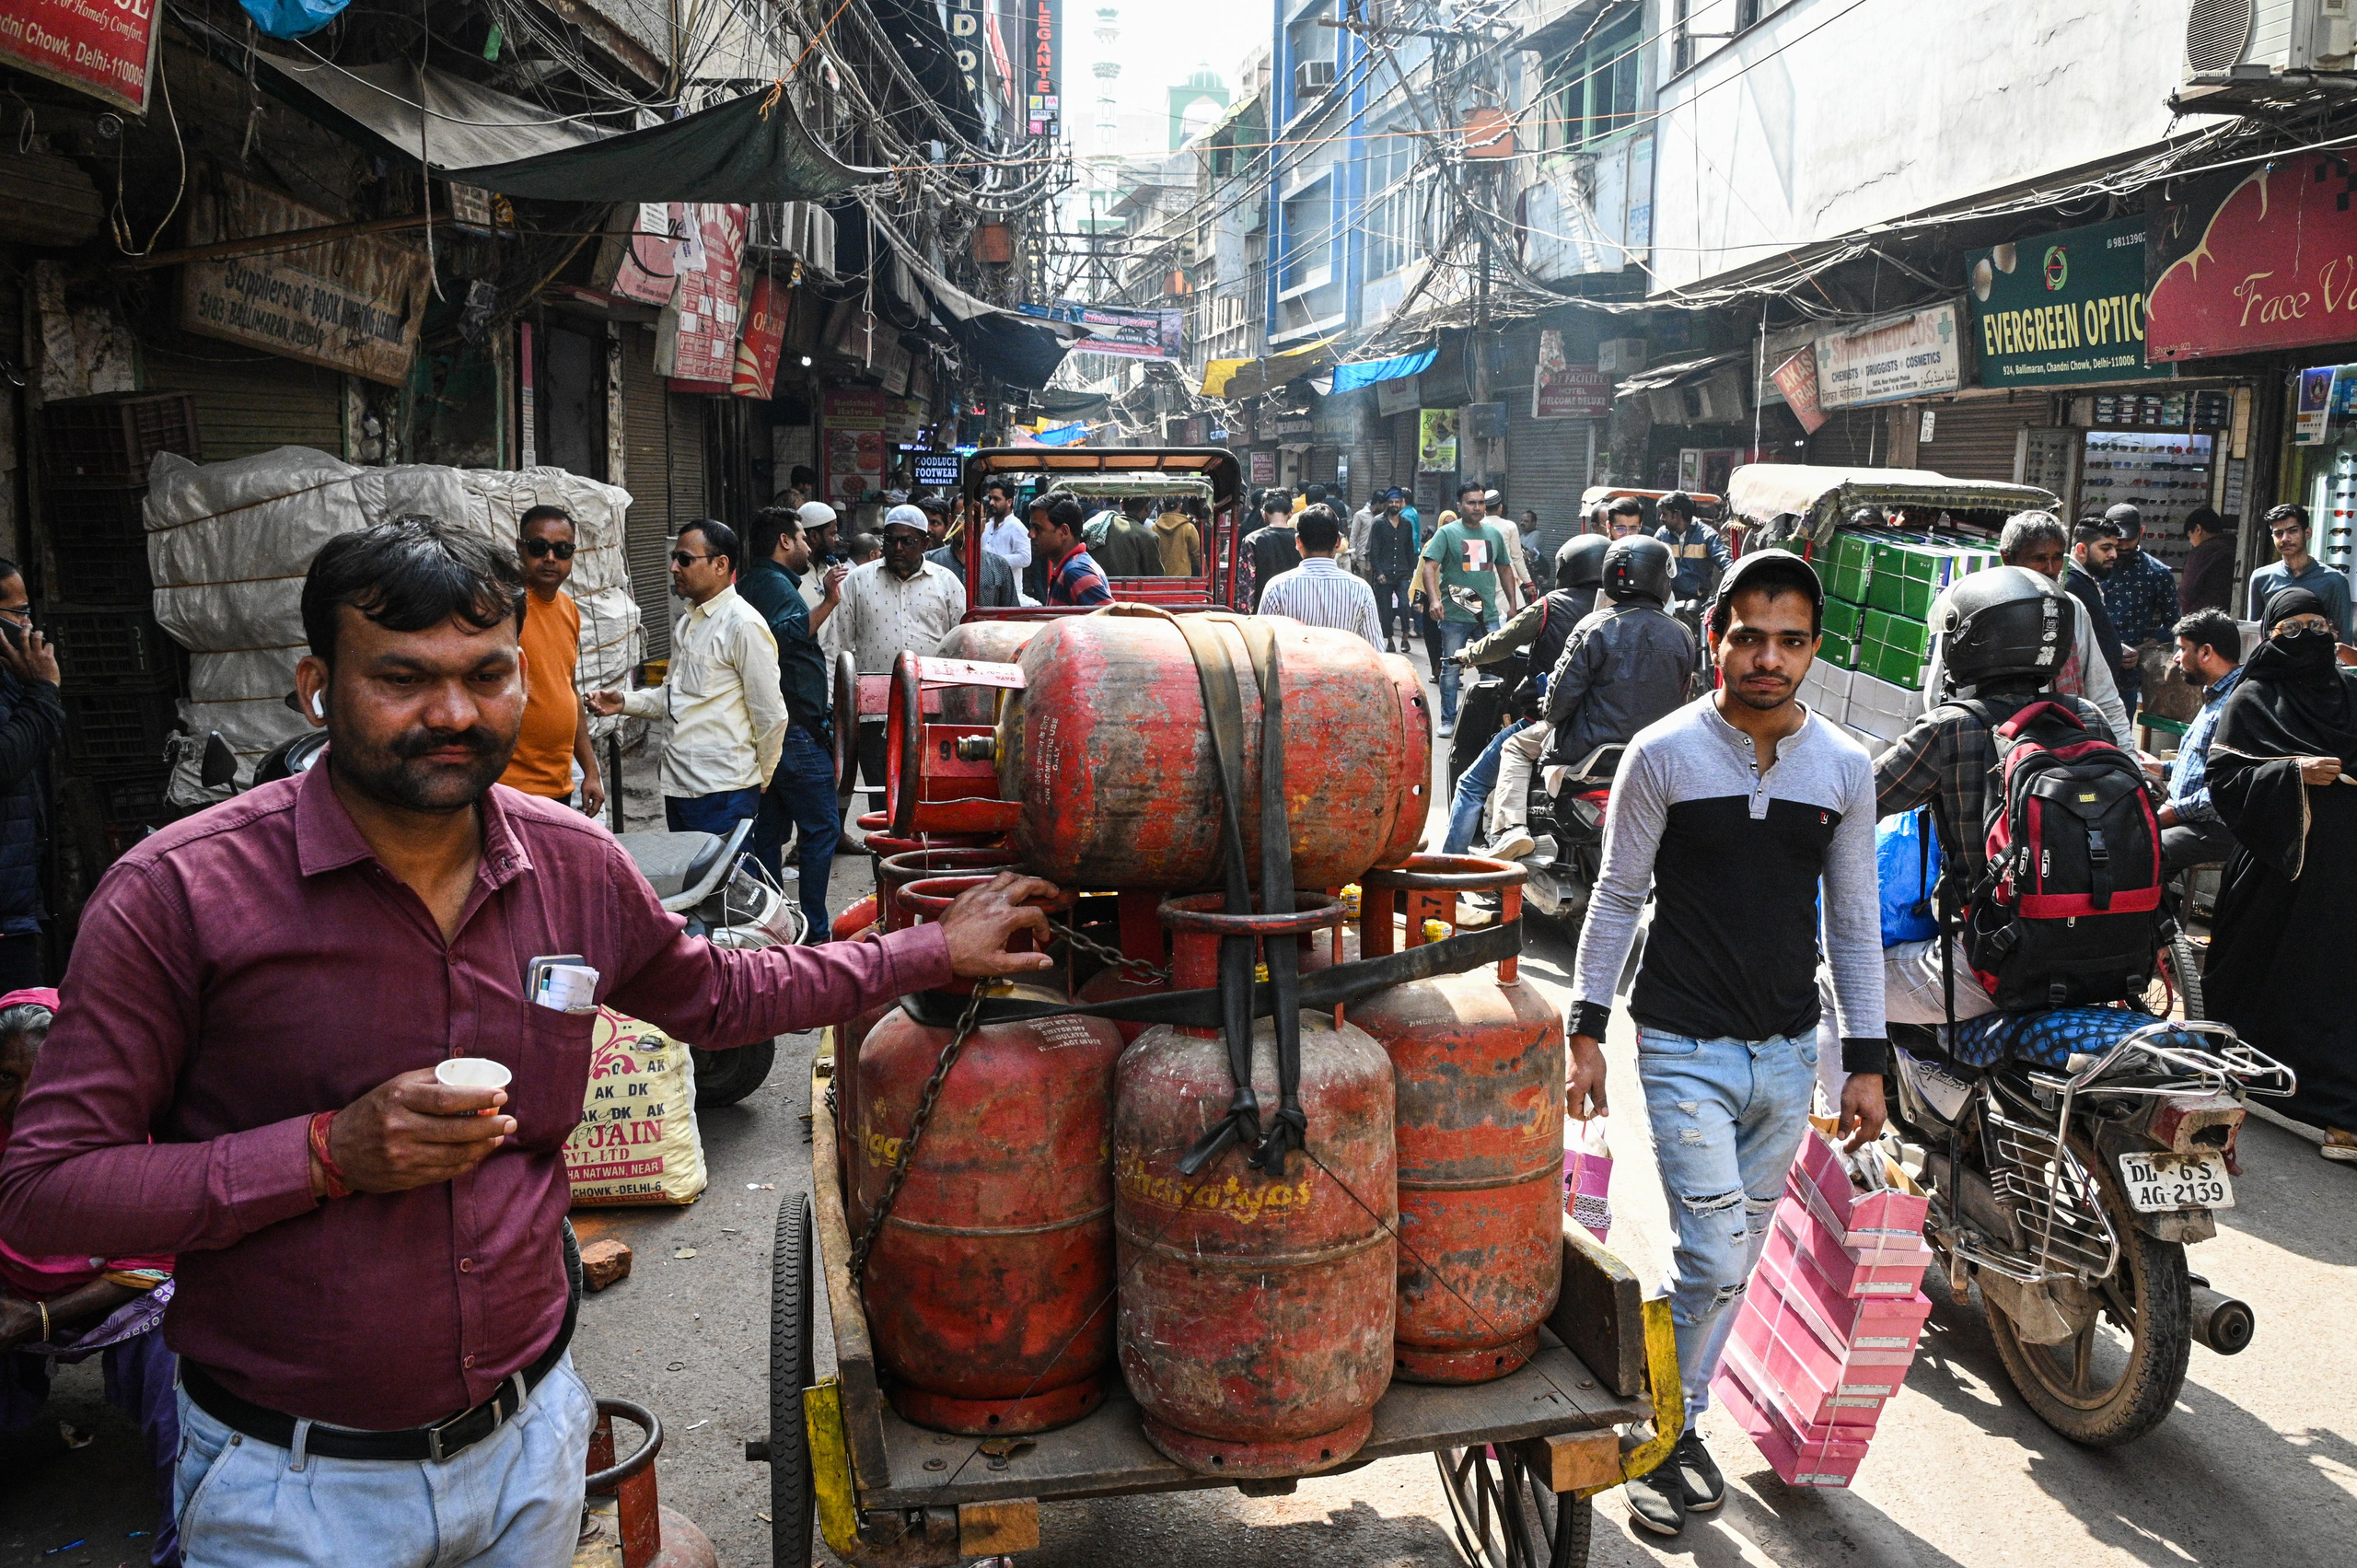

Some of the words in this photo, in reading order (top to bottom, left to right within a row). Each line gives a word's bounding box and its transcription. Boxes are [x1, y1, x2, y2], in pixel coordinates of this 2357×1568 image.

[0, 13, 25, 39] dni
[26, 22, 72, 62] Chowk,
[75, 41, 145, 87] Delhi-110006
[1037, 0, 1051, 92] LEGANTE
[225, 261, 291, 308] Suppliers
[311, 286, 342, 323] BOOK
[2234, 271, 2310, 327] Face
[1983, 303, 2081, 355] EVERGREEN
[2084, 293, 2145, 346] OPTIC
[1831, 367, 1859, 383] CHEMISTS
[1866, 359, 1898, 377] DRUGGISTS
[1906, 351, 1941, 369] COSMETICS
[2003, 366, 2015, 376] 924,
[2015, 364, 2046, 375] Ballimaran,
[2047, 361, 2069, 372] Chandni
[2070, 359, 2092, 371] Chowk,
[2093, 354, 2135, 368] Delhi-110006
[1540, 397, 1576, 406] WELCOME
[1577, 397, 1606, 406] DELUXE
[1254, 454, 1272, 462] NOBLE
[915, 468, 958, 478] FOOTWEAR
[1044, 738, 1053, 784] DOMESTIC
[1049, 717, 1059, 736] USE
[1041, 1027, 1072, 1036] SWITCH
[1046, 1032, 1090, 1042] REGULATOR
[647, 1060, 666, 1073] AK
[595, 1086, 614, 1099] AK
[629, 1083, 648, 1097] DK
[611, 1107, 632, 1120] DK
[646, 1103, 666, 1117] AK
[588, 1120, 663, 1149] JAIN
[600, 1148, 630, 1162] LTD
[631, 1162, 658, 1174] NEAR
[2130, 1164, 2157, 1182] DL
[572, 1185, 612, 1198] CHOWK
[2140, 1182, 2223, 1205] AG-2139
